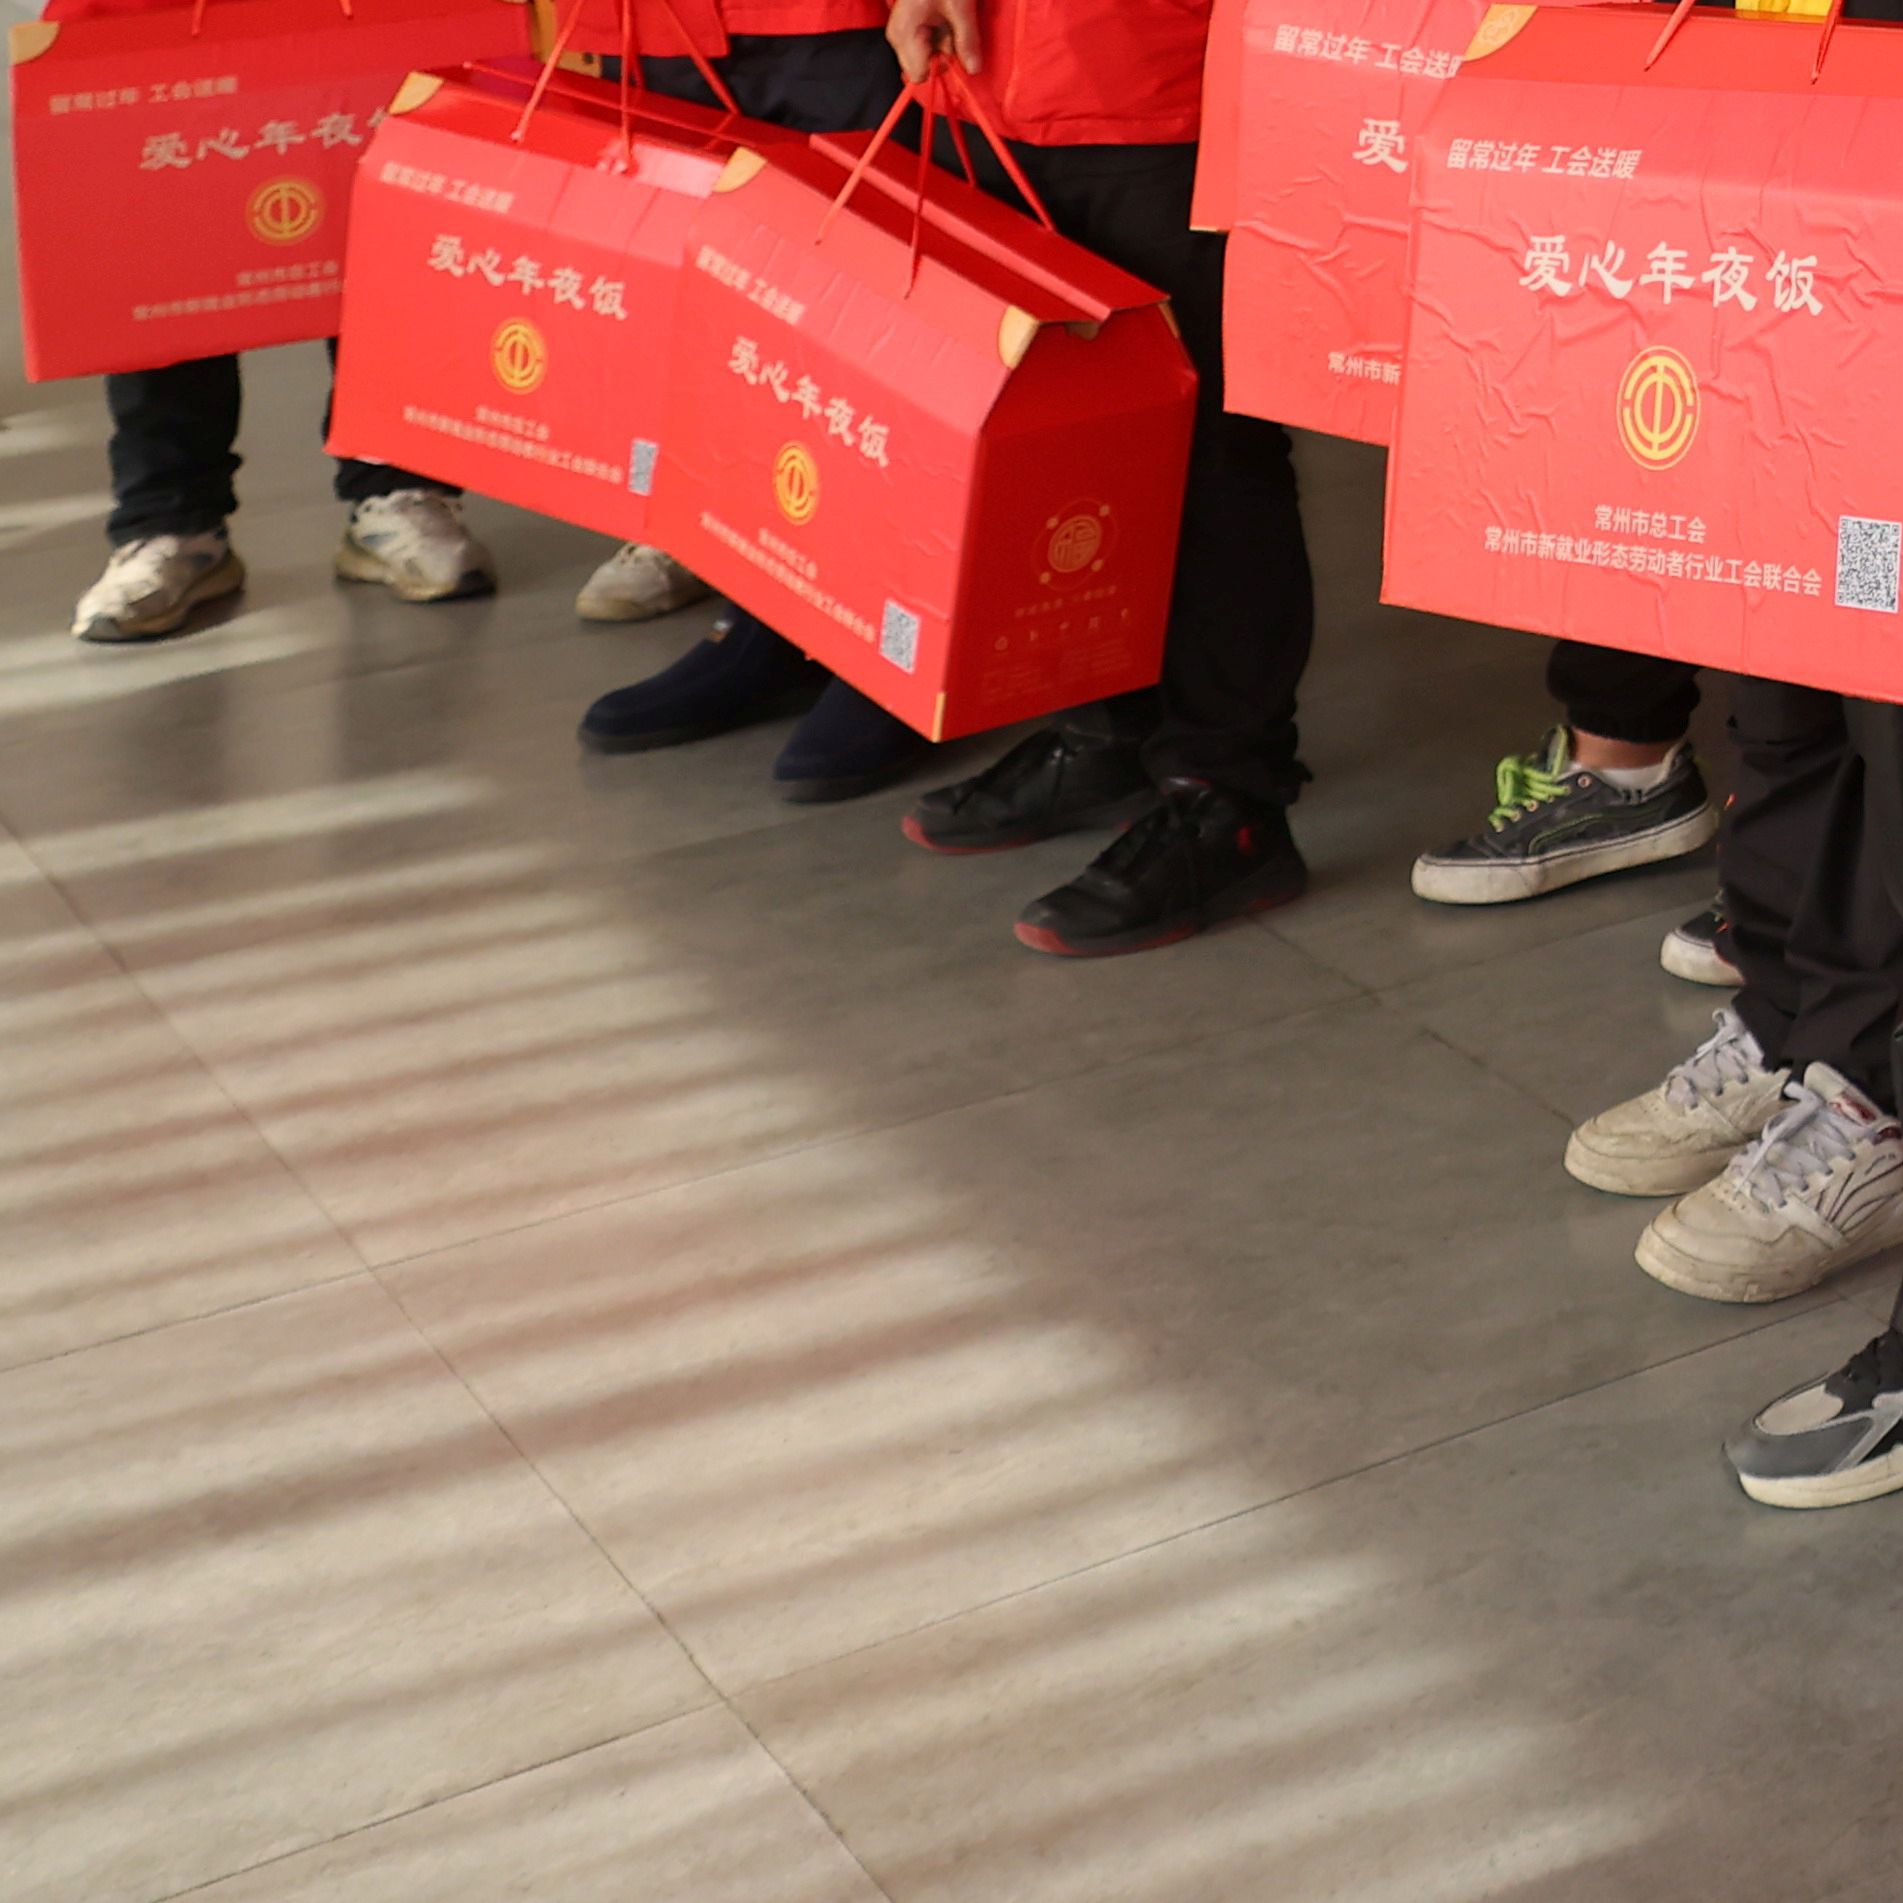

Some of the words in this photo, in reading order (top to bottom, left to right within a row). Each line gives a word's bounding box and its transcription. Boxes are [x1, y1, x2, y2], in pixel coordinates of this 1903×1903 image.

[1275, 24, 1371, 64] 留常过年
[138, 105, 387, 170] 爱心年夜
[1447, 138, 1541, 173] 留常过年
[1541, 145, 1643, 179] 工会送暖
[427, 234, 629, 321] 爱心年夜饭
[1517, 232, 1825, 318] 爱心年夜饭
[728, 335, 892, 468] 爱心年夜饭
[1594, 504, 1708, 544] 常州市总工会
[1484, 525, 1823, 597] 常州市新就业形态劳动者行业工会联合会
